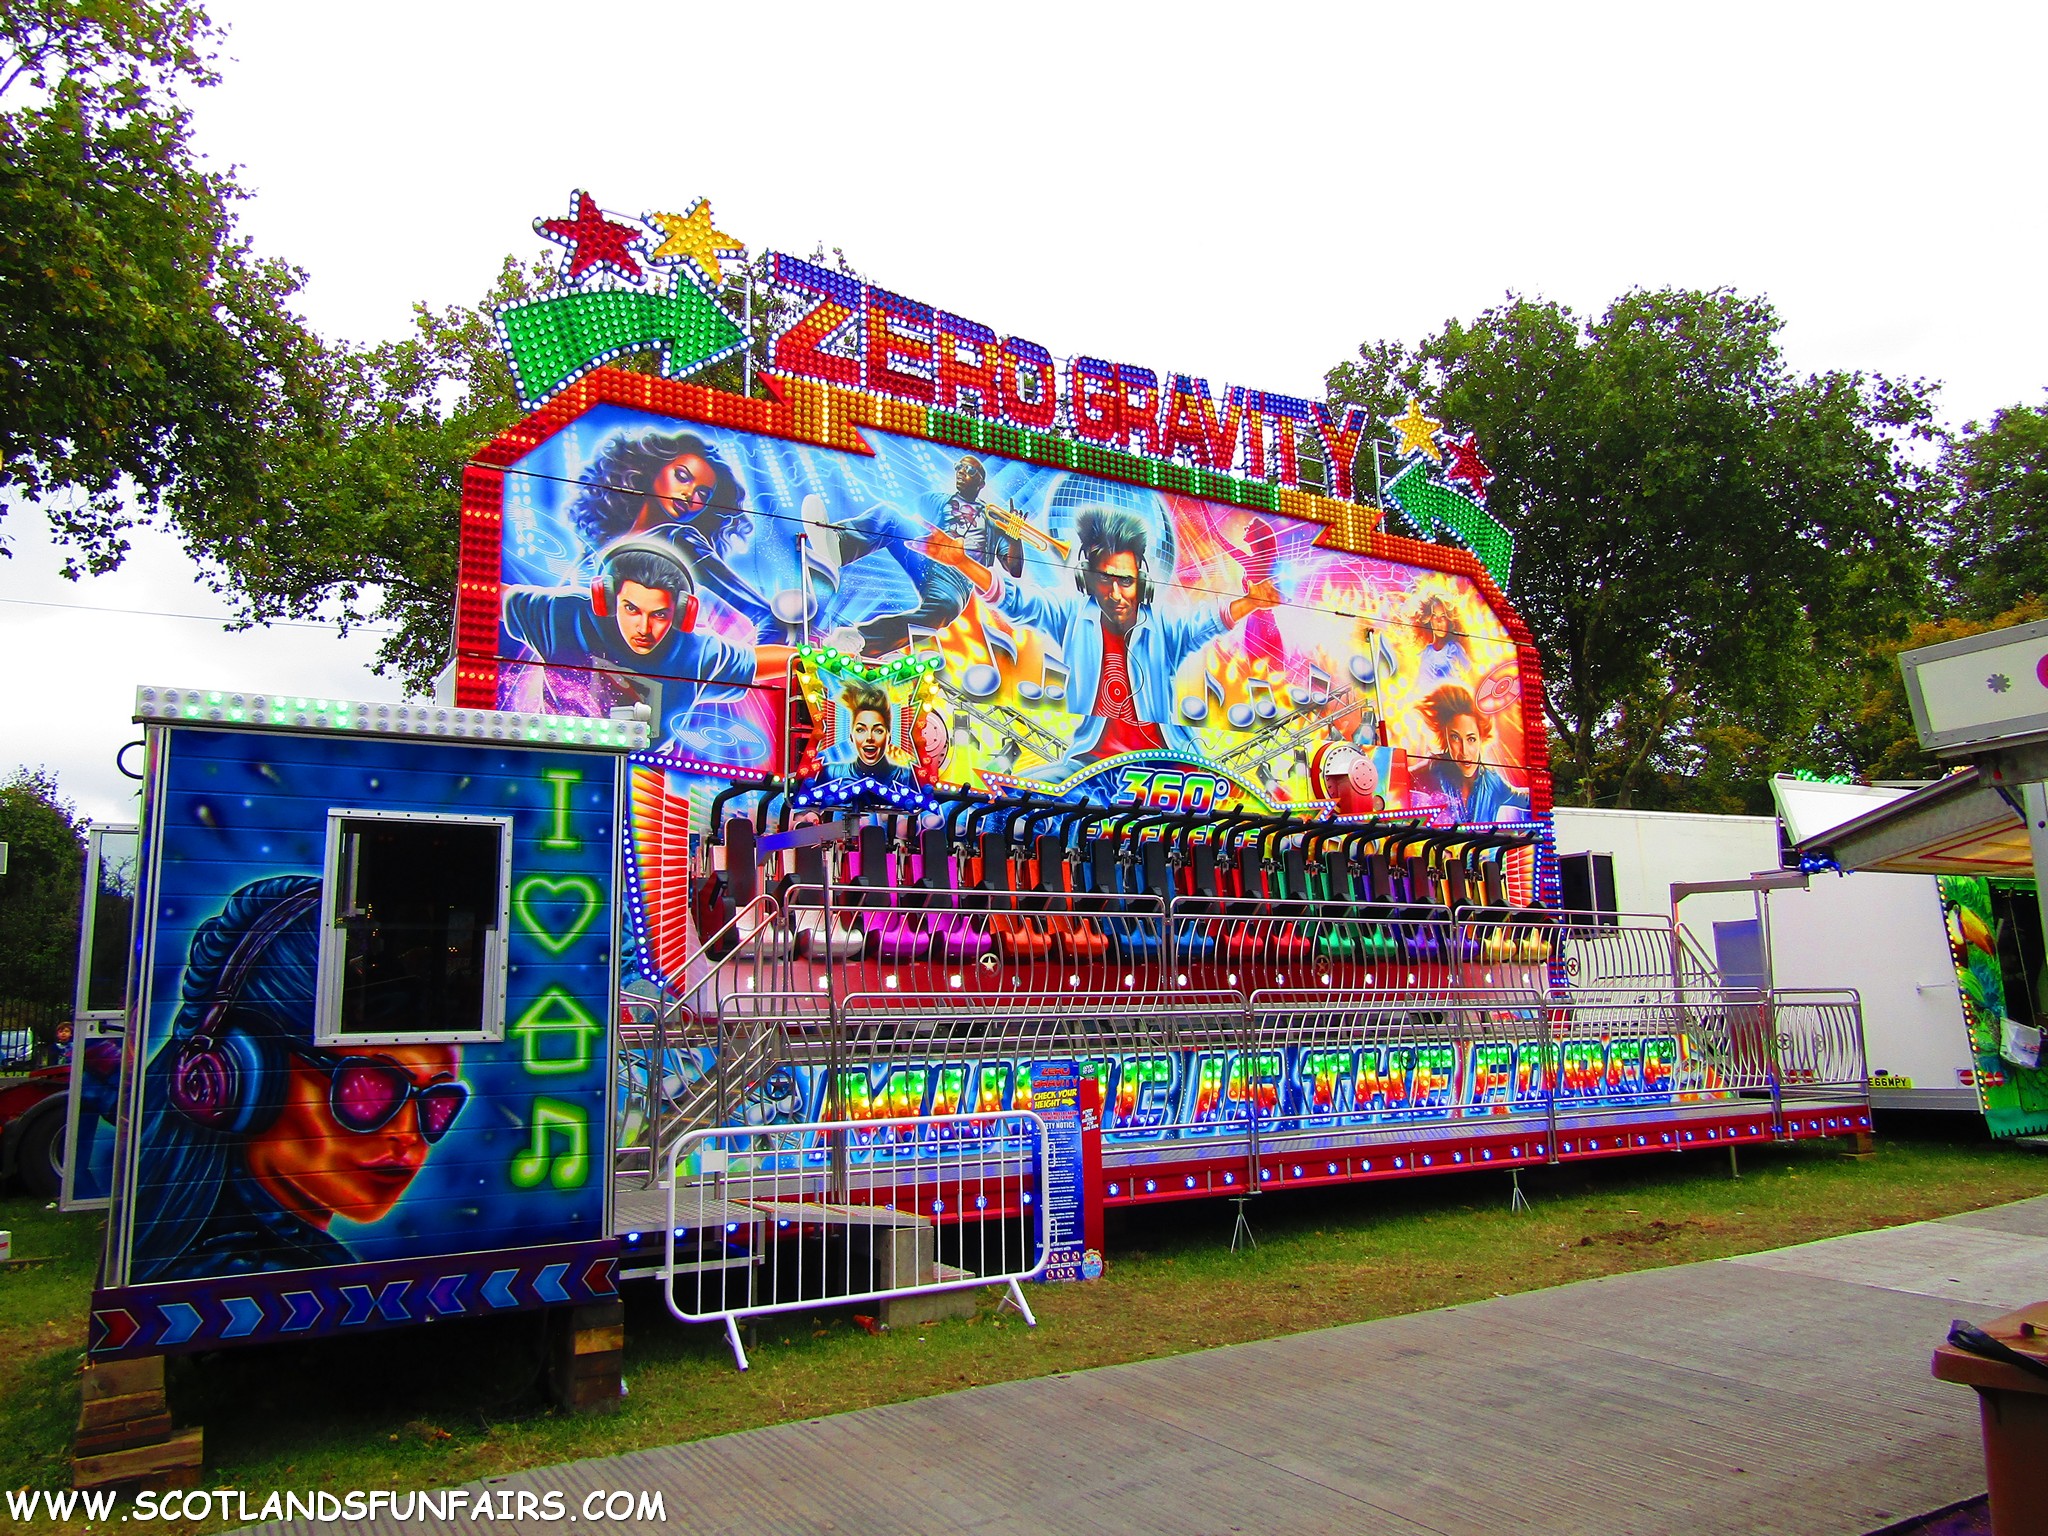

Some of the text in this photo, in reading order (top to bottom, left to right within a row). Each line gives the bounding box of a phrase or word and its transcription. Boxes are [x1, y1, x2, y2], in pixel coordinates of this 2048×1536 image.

[766, 249, 1370, 502] ZERO GRAVITY
[542, 768, 582, 849] I
[1033, 1088, 1078, 1101] CHECK YOUR
[1035, 1099, 1060, 1109] HEIGHT
[1301, 1045, 1456, 1123] THE
[1469, 1039, 1677, 1114] FORCE
[1056, 1121, 1075, 1129] NOTICE
